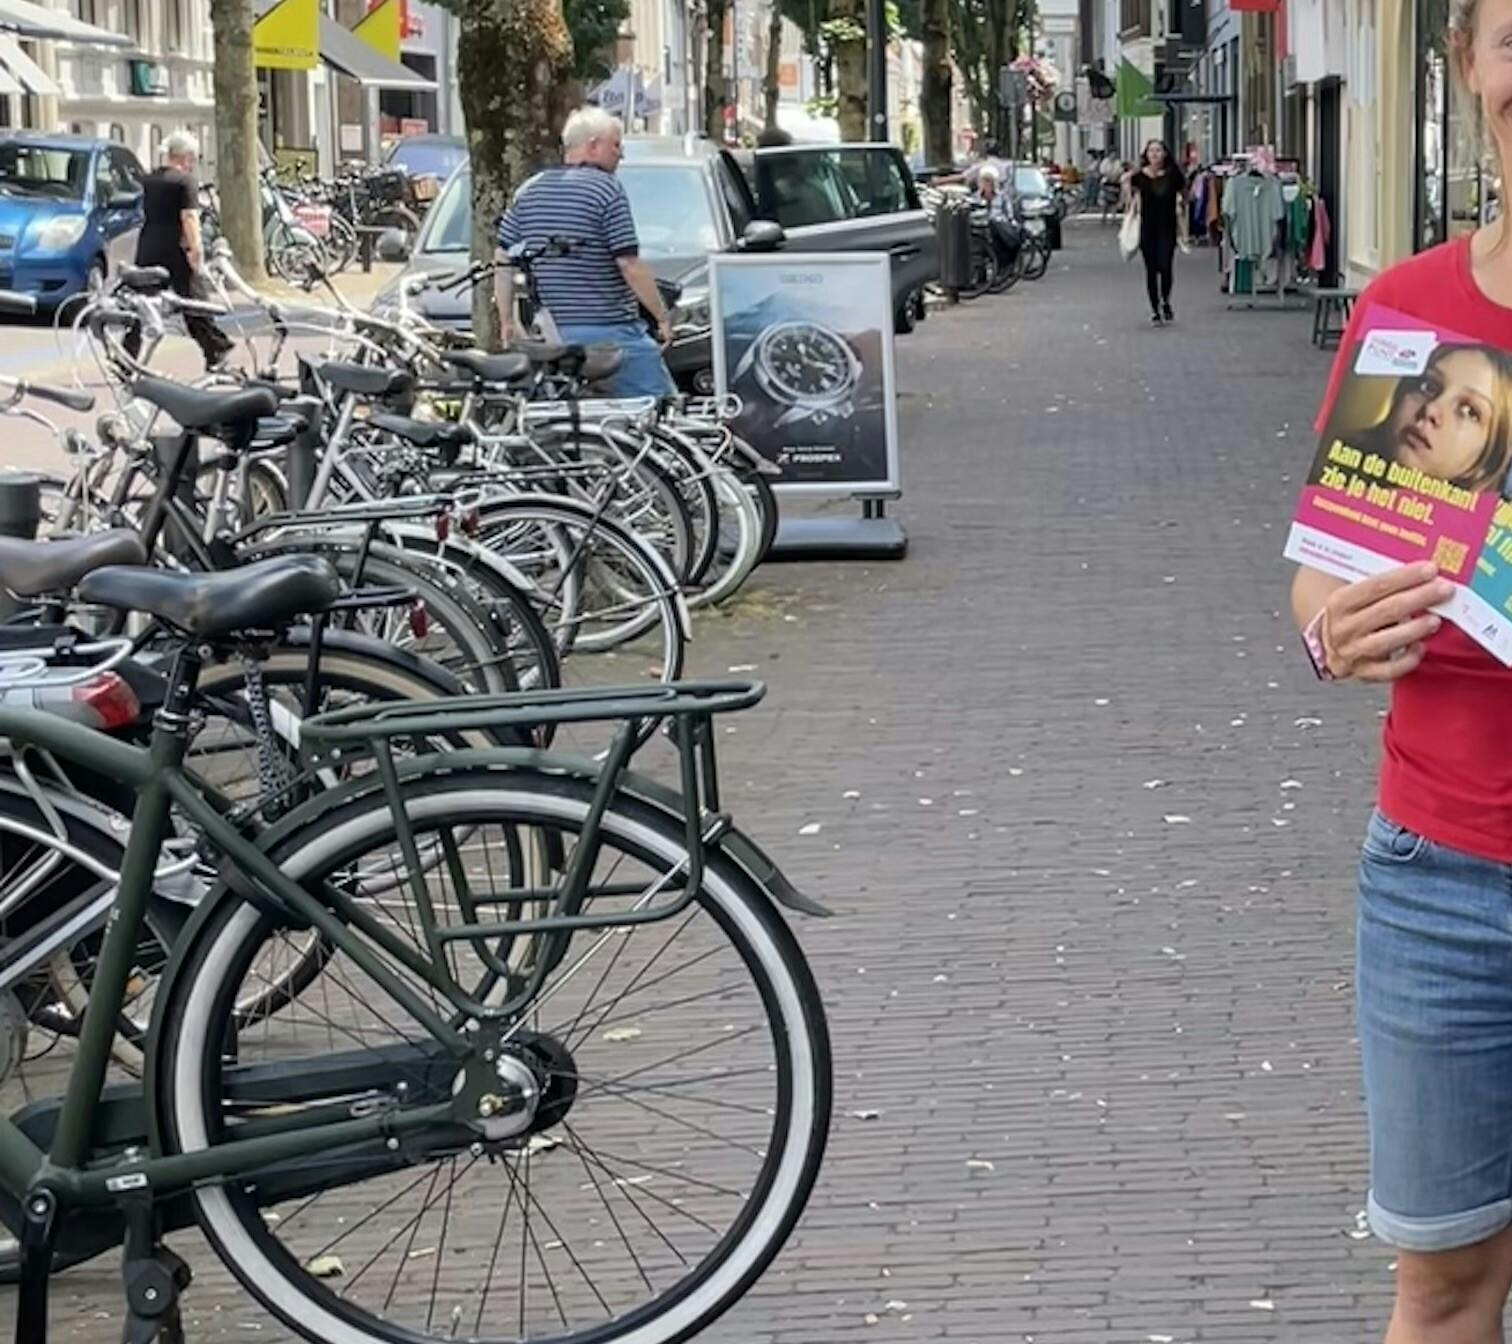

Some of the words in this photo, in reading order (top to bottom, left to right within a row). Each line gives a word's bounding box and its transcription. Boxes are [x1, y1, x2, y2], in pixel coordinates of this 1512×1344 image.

[1320, 466, 1347, 490] zie
[1346, 474, 1366, 498] je
[1366, 481, 1397, 511] het
[1328, 439, 1362, 469] Aan
[1363, 454, 1387, 477] de
[1387, 462, 1480, 512] buitenkant
